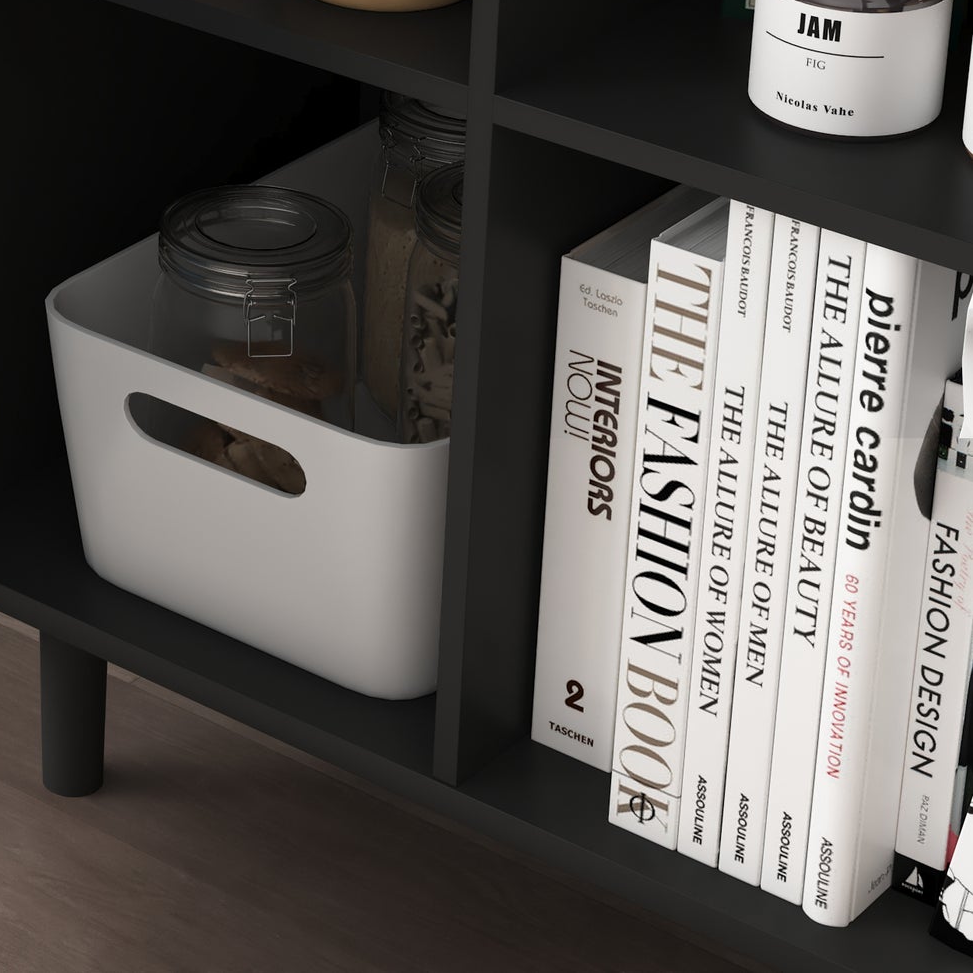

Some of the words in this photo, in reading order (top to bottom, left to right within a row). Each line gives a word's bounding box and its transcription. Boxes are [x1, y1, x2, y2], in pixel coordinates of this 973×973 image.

[797, 13, 842, 42] JAM
[806, 58, 826, 70] FIG
[776, 91, 818, 112] Nicolas
[823, 104, 855, 117] Vahe
[740, 205, 755, 266] FRANCOIS
[787, 219, 801, 280] FRANCOIS
[579, 284, 593, 296] Ed.
[583, 297, 618, 317] Taschen
[737, 267, 750, 318] BAUDOT
[782, 281, 795, 333] BAUDOT
[823, 255, 852, 324] THE
[649, 262, 712, 391] THE
[859, 287, 902, 413] pierre
[564, 349, 595, 441] NOW!
[721, 386, 745, 444] THE
[810, 327, 844, 461] ALLURE
[587, 360, 622, 521] INTERIORS
[765, 402, 788, 460] THE
[711, 447, 739, 560] ALLURE
[755, 463, 782, 576] ALLURE
[806, 466, 831, 512] OF
[845, 426, 882, 551] cardin
[629, 391, 702, 664] FASHION
[708, 565, 729, 605] OF
[752, 581, 772, 620] OF
[793, 513, 827, 648] BEAUTY
[844, 574, 859, 594] 60
[922, 522, 960, 659] FASHION
[745, 623, 768, 688] MEN
[838, 600, 857, 651] YEARS
[565, 679, 584, 713] 2
[698, 611, 726, 717] WOMEN
[837, 656, 851, 678] OF
[549, 720, 594, 747] TASCHEN
[616, 659, 679, 834] BOOK
[826, 681, 849, 779] INNOVATION
[910, 664, 944, 778] DESIGN
[692, 774, 707, 846] ASSOULINE
[734, 793, 750, 864] ASSOULINE
[777, 811, 793, 883] ASSOULINE
[815, 837, 834, 909] ASSOULINE
